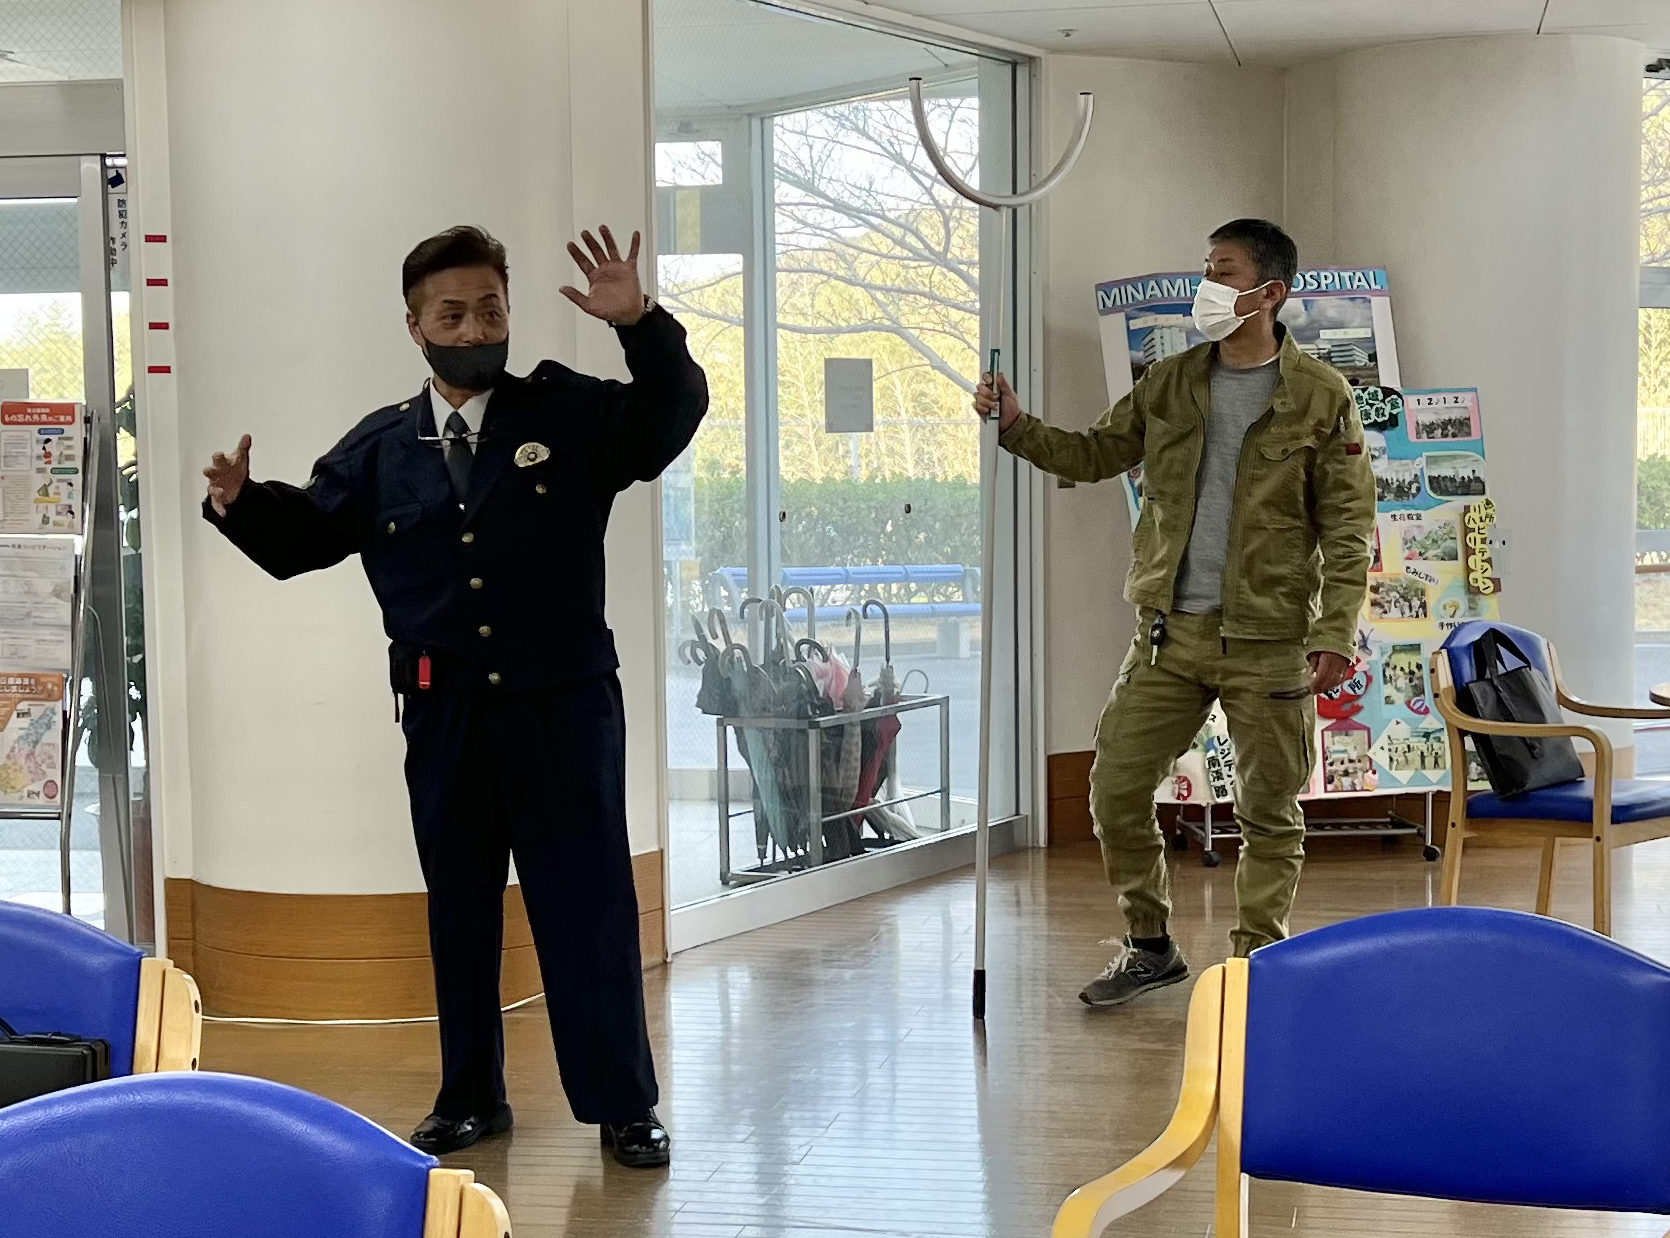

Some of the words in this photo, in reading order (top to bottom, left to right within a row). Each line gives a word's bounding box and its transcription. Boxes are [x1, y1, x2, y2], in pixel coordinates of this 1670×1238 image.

[117, 199, 128, 251] 防犯カメラ
[1290, 270, 1384, 292] OSPITAL
[1363, 398, 1401, 421] 康教室
